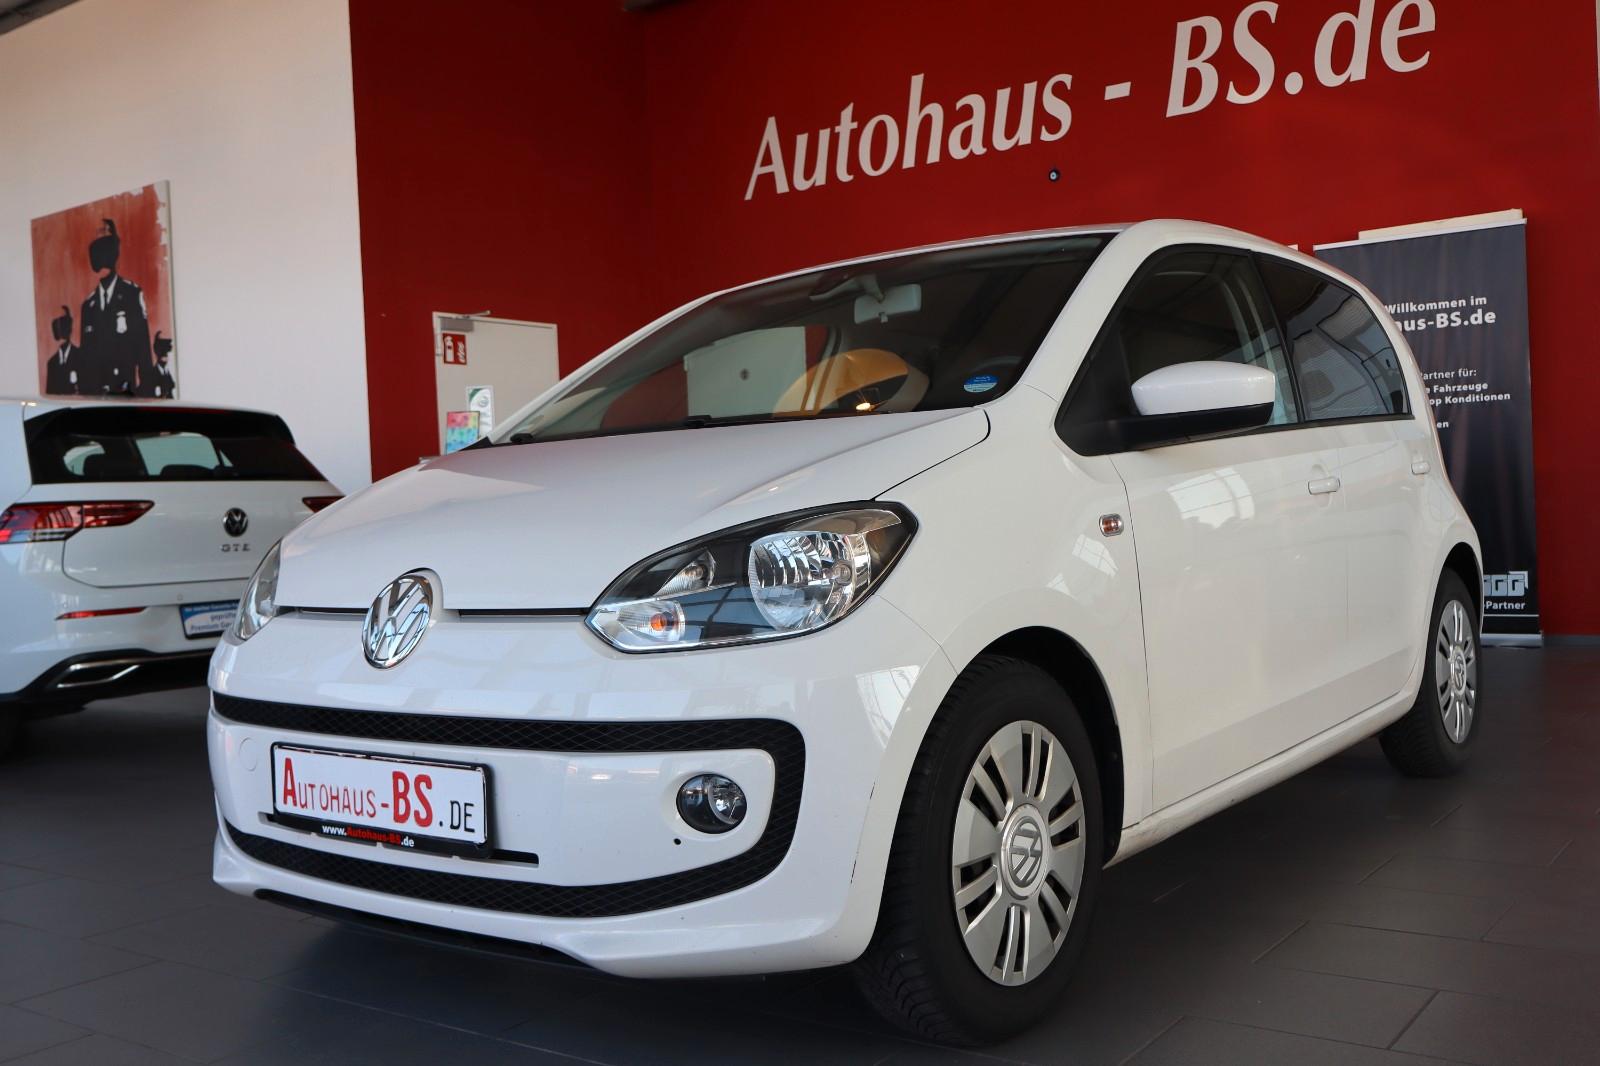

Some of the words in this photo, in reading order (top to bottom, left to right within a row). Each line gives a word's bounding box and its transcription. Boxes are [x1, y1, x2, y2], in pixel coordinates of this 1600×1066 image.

[744, 73, 1073, 201] Autohaus
[1165, 0, 1436, 118] BS.de
[1385, 299, 1466, 314] Willkommen
[1470, 296, 1487, 306] im
[1420, 370, 1455, 380] artner
[1458, 368, 1477, 377] für:
[1433, 382, 1489, 393] Fahrzeuge
[1444, 393, 1511, 404] Konditionen
[322, 824, 415, 847] www.Autohaus-BS.de
